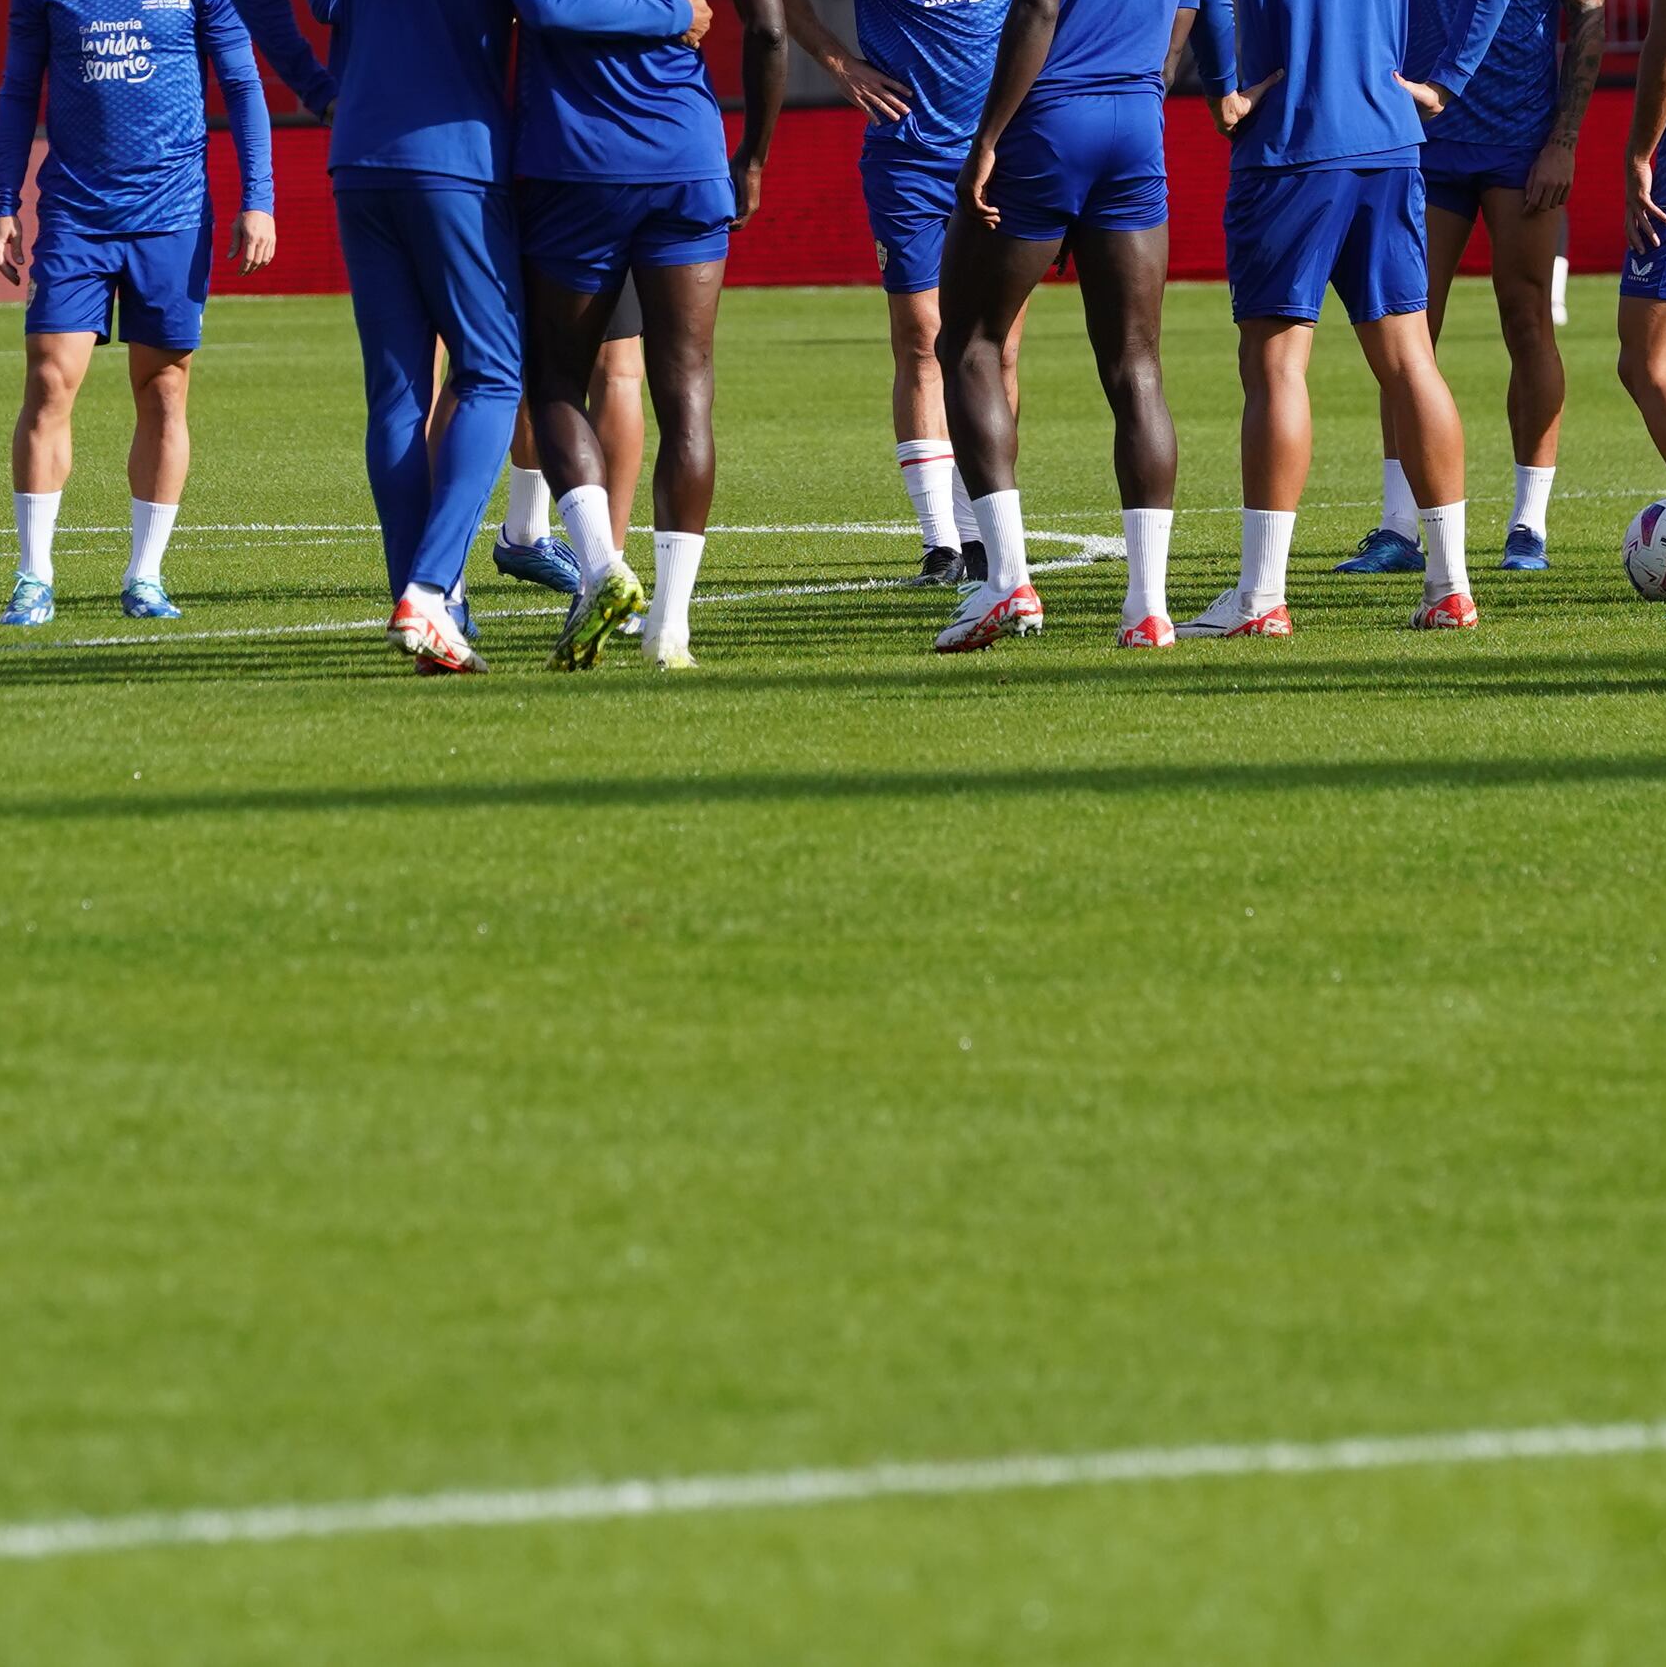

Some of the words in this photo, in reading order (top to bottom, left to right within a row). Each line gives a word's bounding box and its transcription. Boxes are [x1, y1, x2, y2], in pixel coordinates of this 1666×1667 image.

[81, 38, 94, 52] la
[95, 33, 138, 55] vida
[140, 37, 152, 50] te
